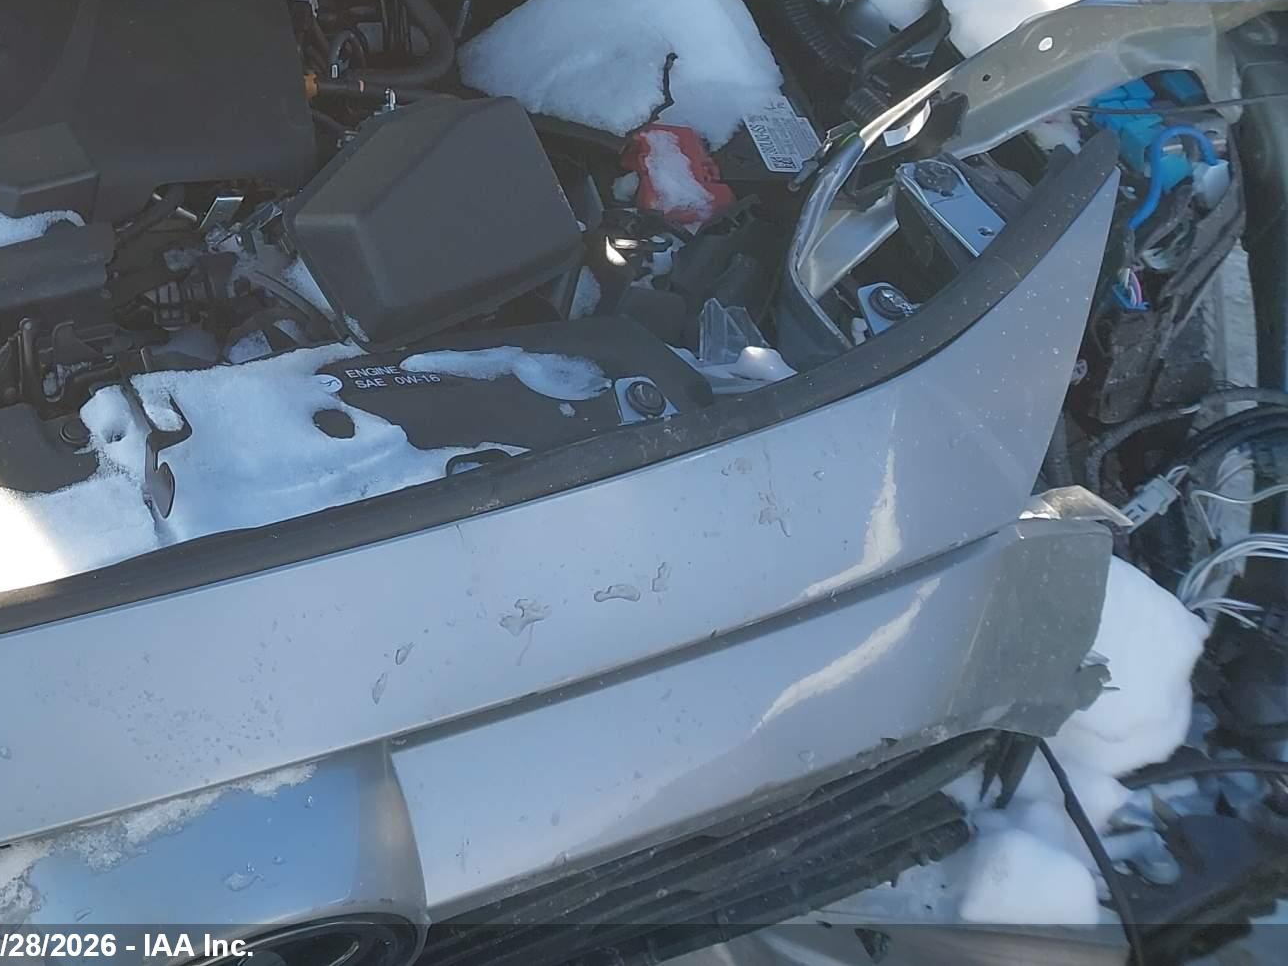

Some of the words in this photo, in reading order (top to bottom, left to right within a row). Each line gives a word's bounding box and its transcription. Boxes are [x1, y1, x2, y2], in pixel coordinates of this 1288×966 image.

[345, 365, 401, 379] ENGINE
[354, 377, 388, 389] SAE
[394, 373, 441, 386] 0W-16
